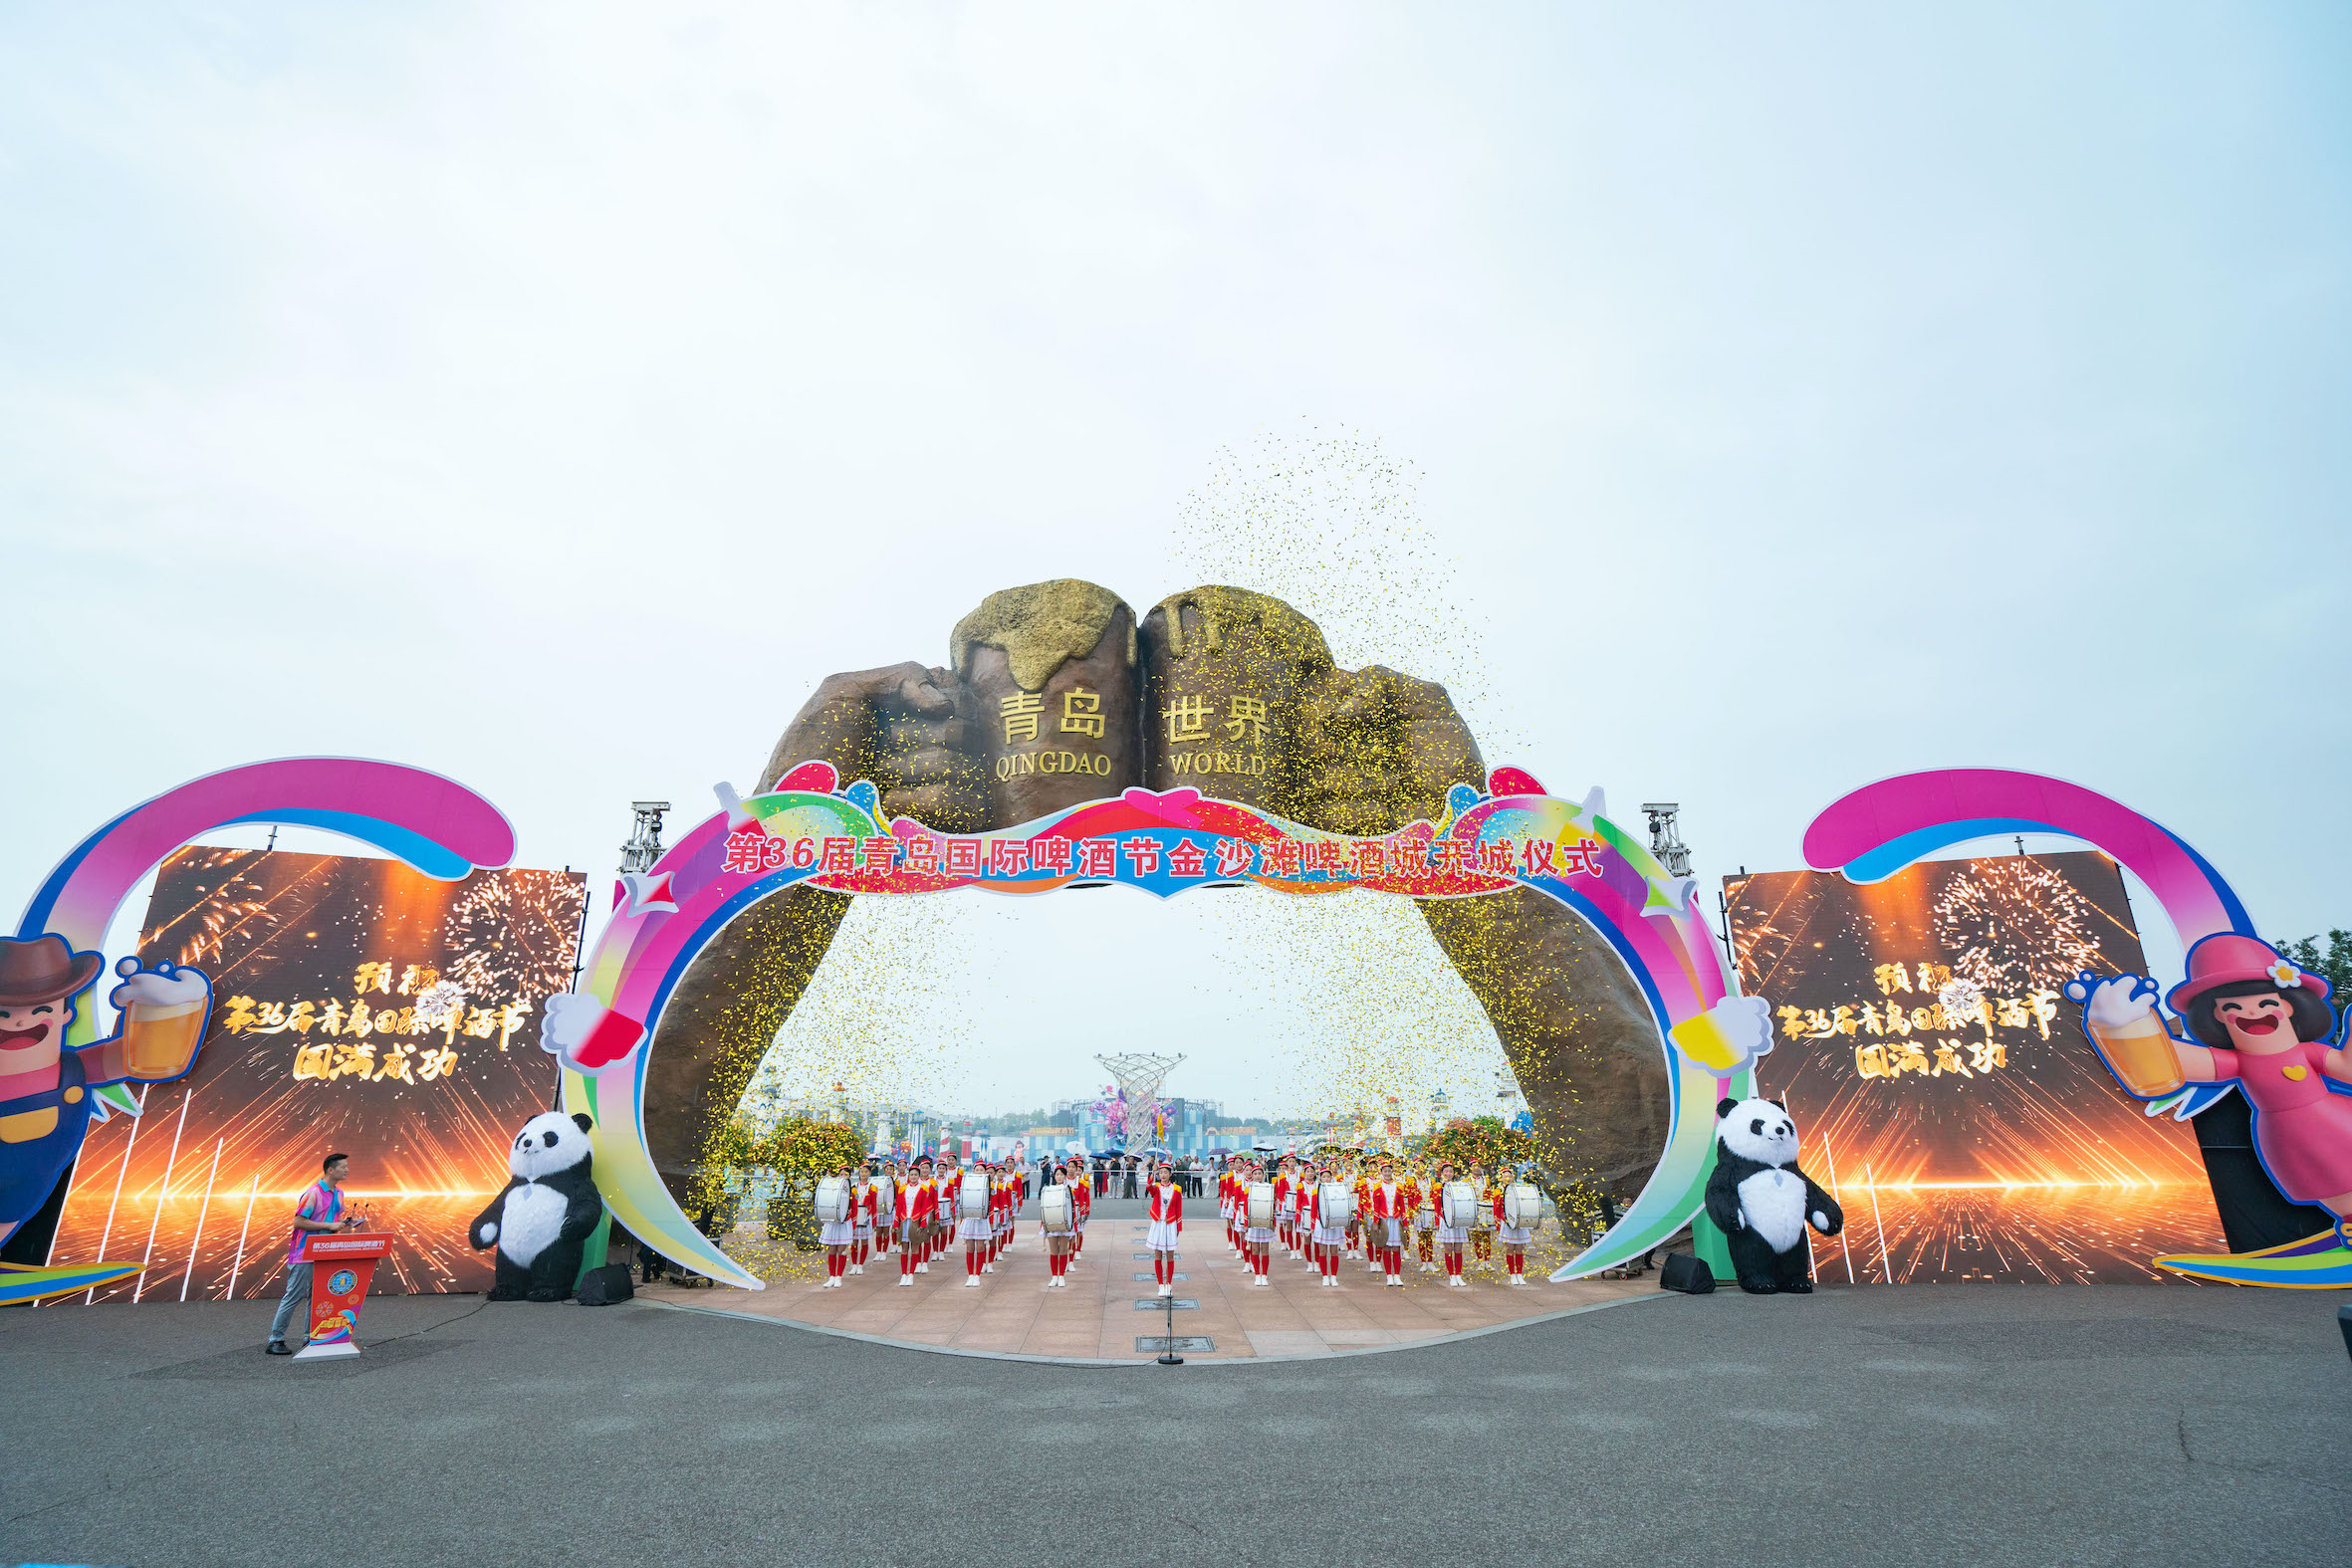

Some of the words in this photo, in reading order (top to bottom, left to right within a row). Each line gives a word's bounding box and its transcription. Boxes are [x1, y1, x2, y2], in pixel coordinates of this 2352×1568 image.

[1000, 687, 1107, 745] 青岛
[996, 751, 1111, 782] QINGDAO
[1169, 750, 1267, 776] WORLD
[721, 832, 1605, 877] 第36届青岛国际啤酒节金沙滩啤酒城开城仪式
[223, 995, 534, 1051] 第36届青岛国际啤酒节
[1776, 989, 2062, 1040] 第36届青岛国际啤酒节
[293, 1042, 458, 1085] 圆满成功
[1855, 1037, 2006, 1079] 圆满成功
